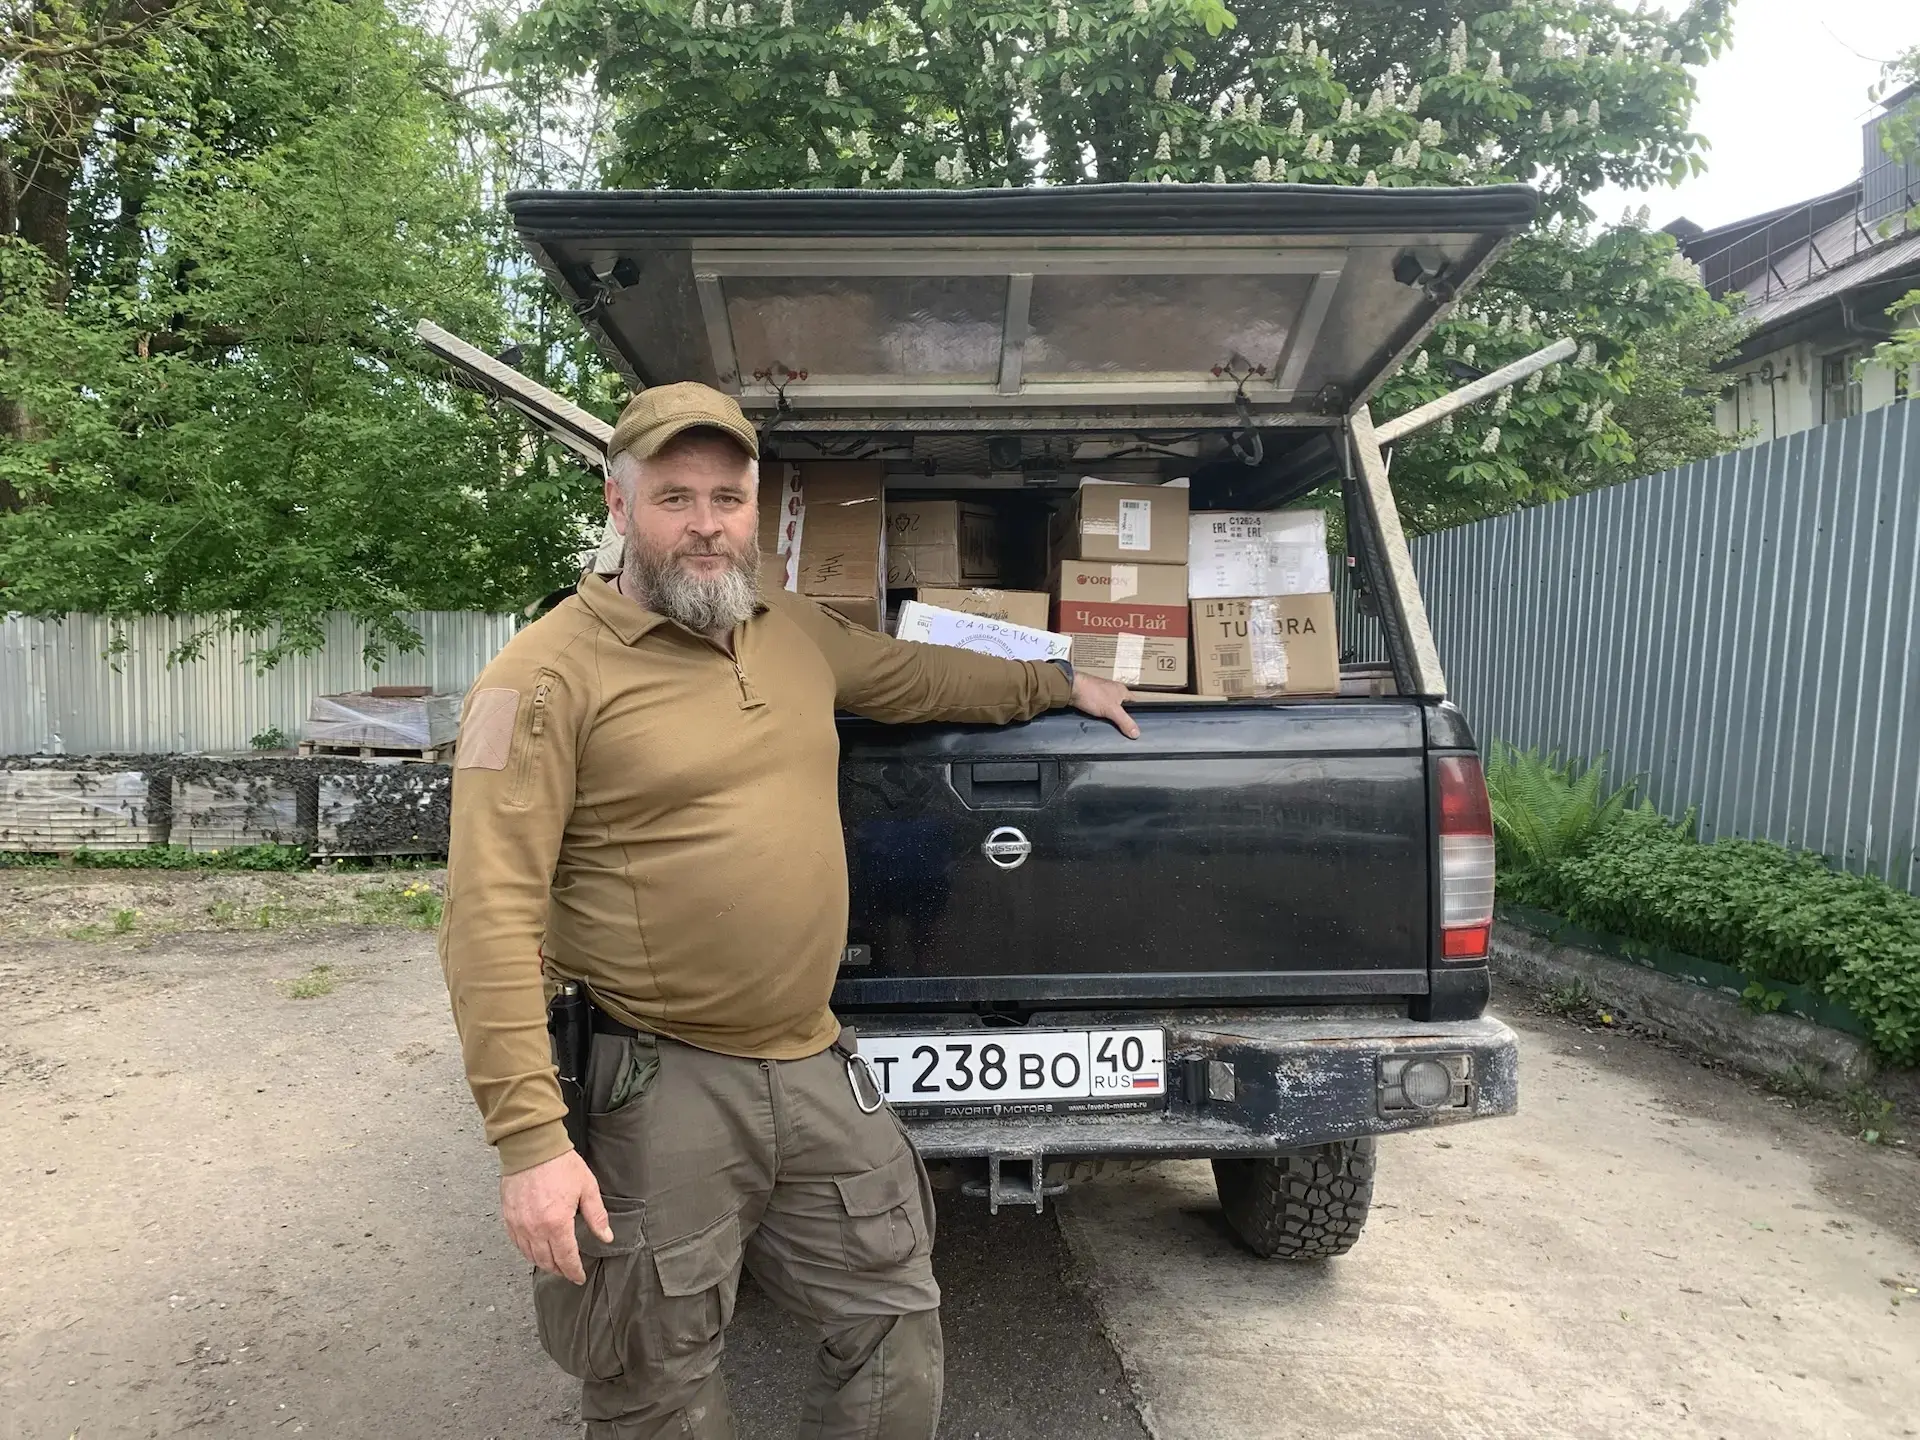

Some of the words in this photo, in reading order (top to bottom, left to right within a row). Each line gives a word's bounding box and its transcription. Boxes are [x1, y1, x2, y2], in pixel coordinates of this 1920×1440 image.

[1219, 617, 1317, 638] TUNDRA
[1159, 658, 1174, 669] 12
[986, 844, 1026, 853] NISSAN
[911, 1043, 1008, 1093] 238
[1018, 1051, 1081, 1091] BO
[1095, 1036, 1144, 1073] 40
[1094, 1075, 1131, 1089] RUS
[944, 1106, 992, 1116] FAVORIT
[1003, 1103, 1054, 1114] MOTORS
